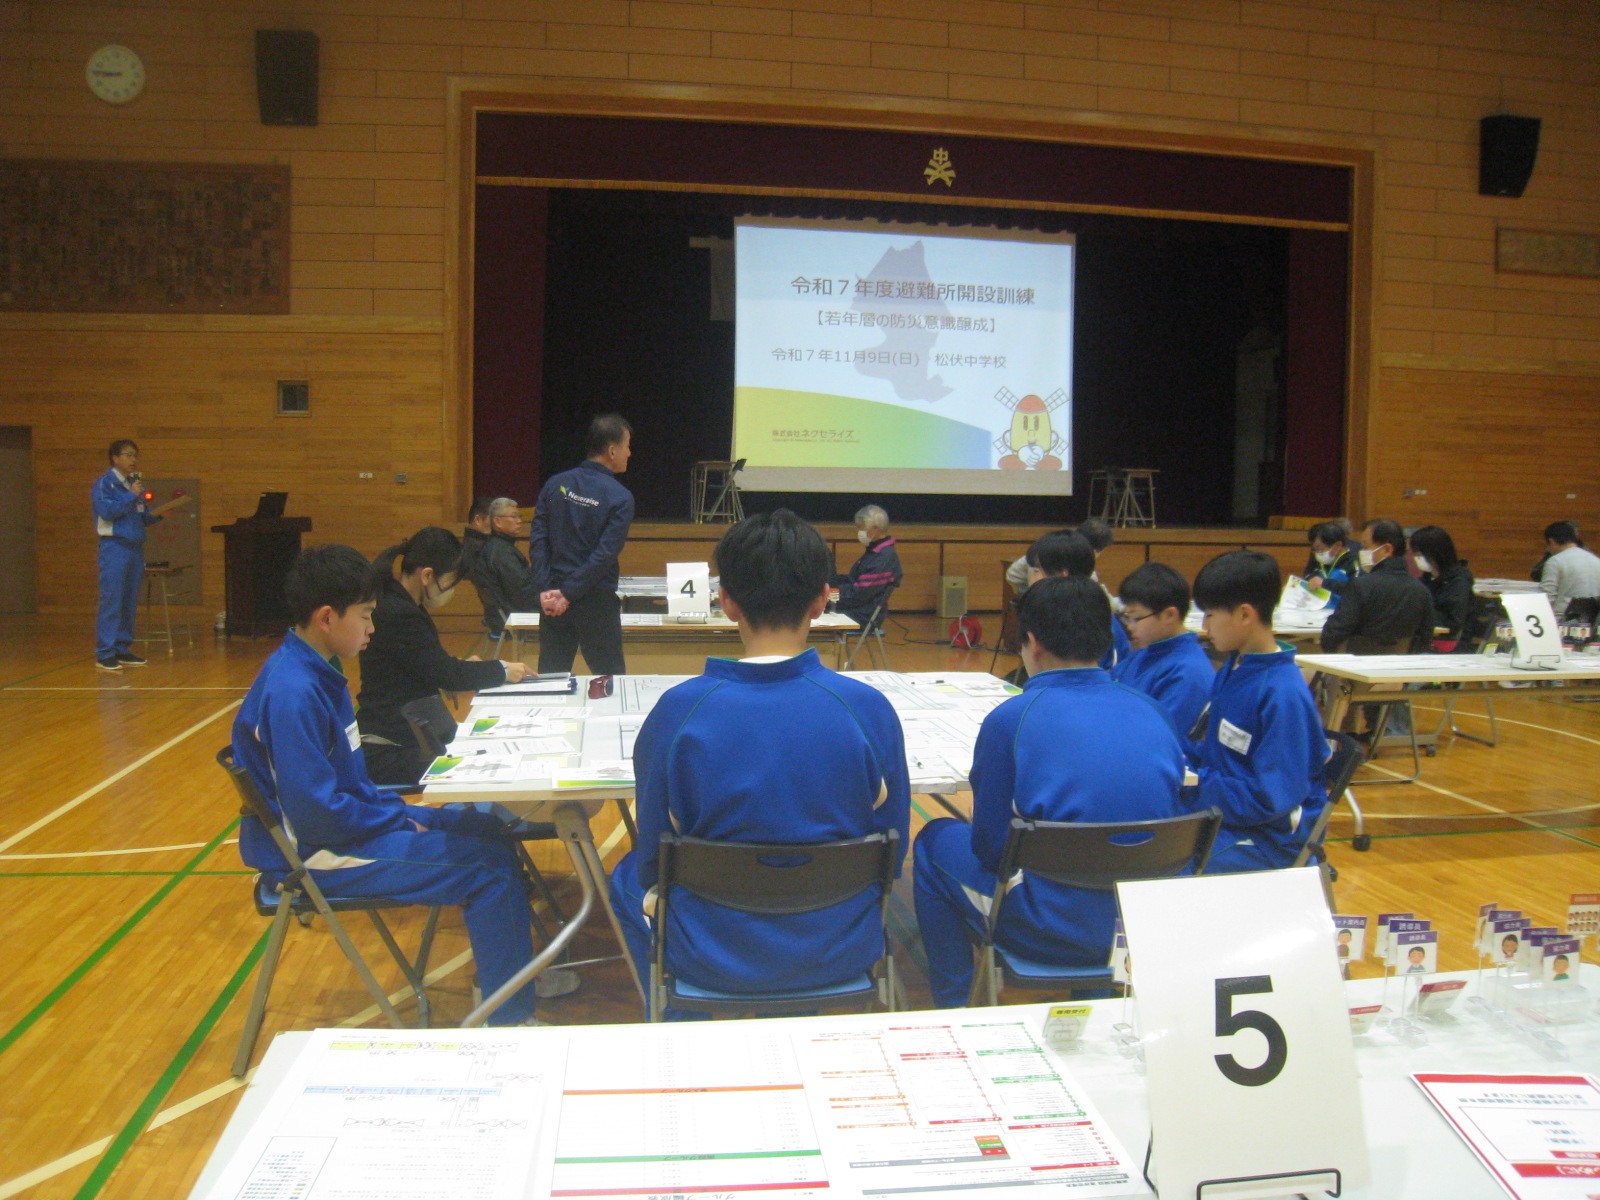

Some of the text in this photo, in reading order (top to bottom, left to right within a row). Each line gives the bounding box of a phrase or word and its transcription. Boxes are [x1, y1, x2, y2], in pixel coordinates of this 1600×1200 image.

[935, 352, 1008, 369] 松伏中学校
[680, 579, 697, 599] 4
[1525, 614, 1545, 638] 3
[1213, 974, 1288, 1087] 5
